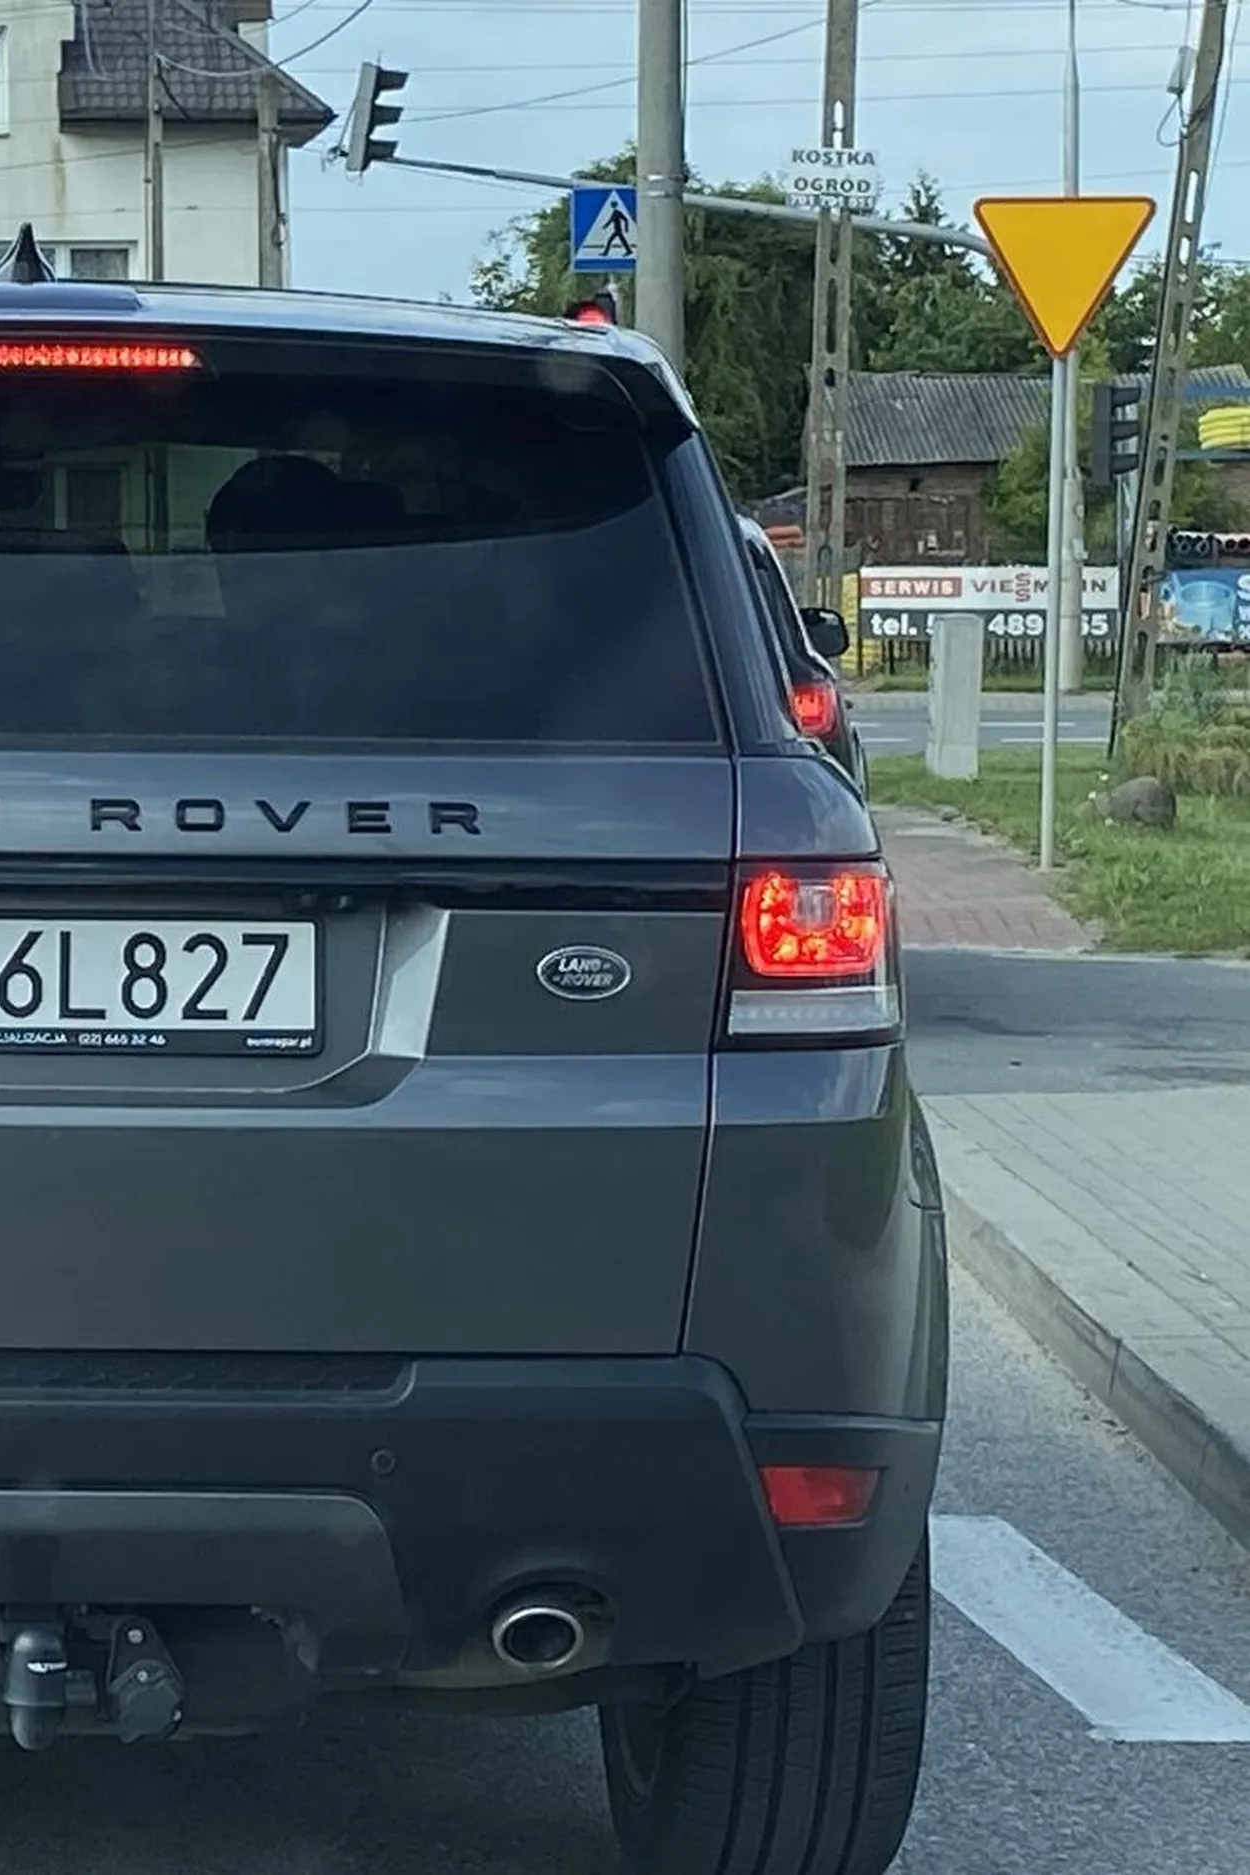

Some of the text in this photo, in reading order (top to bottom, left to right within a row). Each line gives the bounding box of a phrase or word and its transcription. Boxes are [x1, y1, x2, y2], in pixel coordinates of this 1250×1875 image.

[791, 150, 876, 167] KOSTKA
[869, 579, 954, 596] SERWIS
[870, 612, 918, 636] tel.
[987, 613, 1045, 636] 489
[89, 797, 483, 835] ROVER
[558, 957, 602, 973] LAND
[560, 973, 614, 987] ROVER
